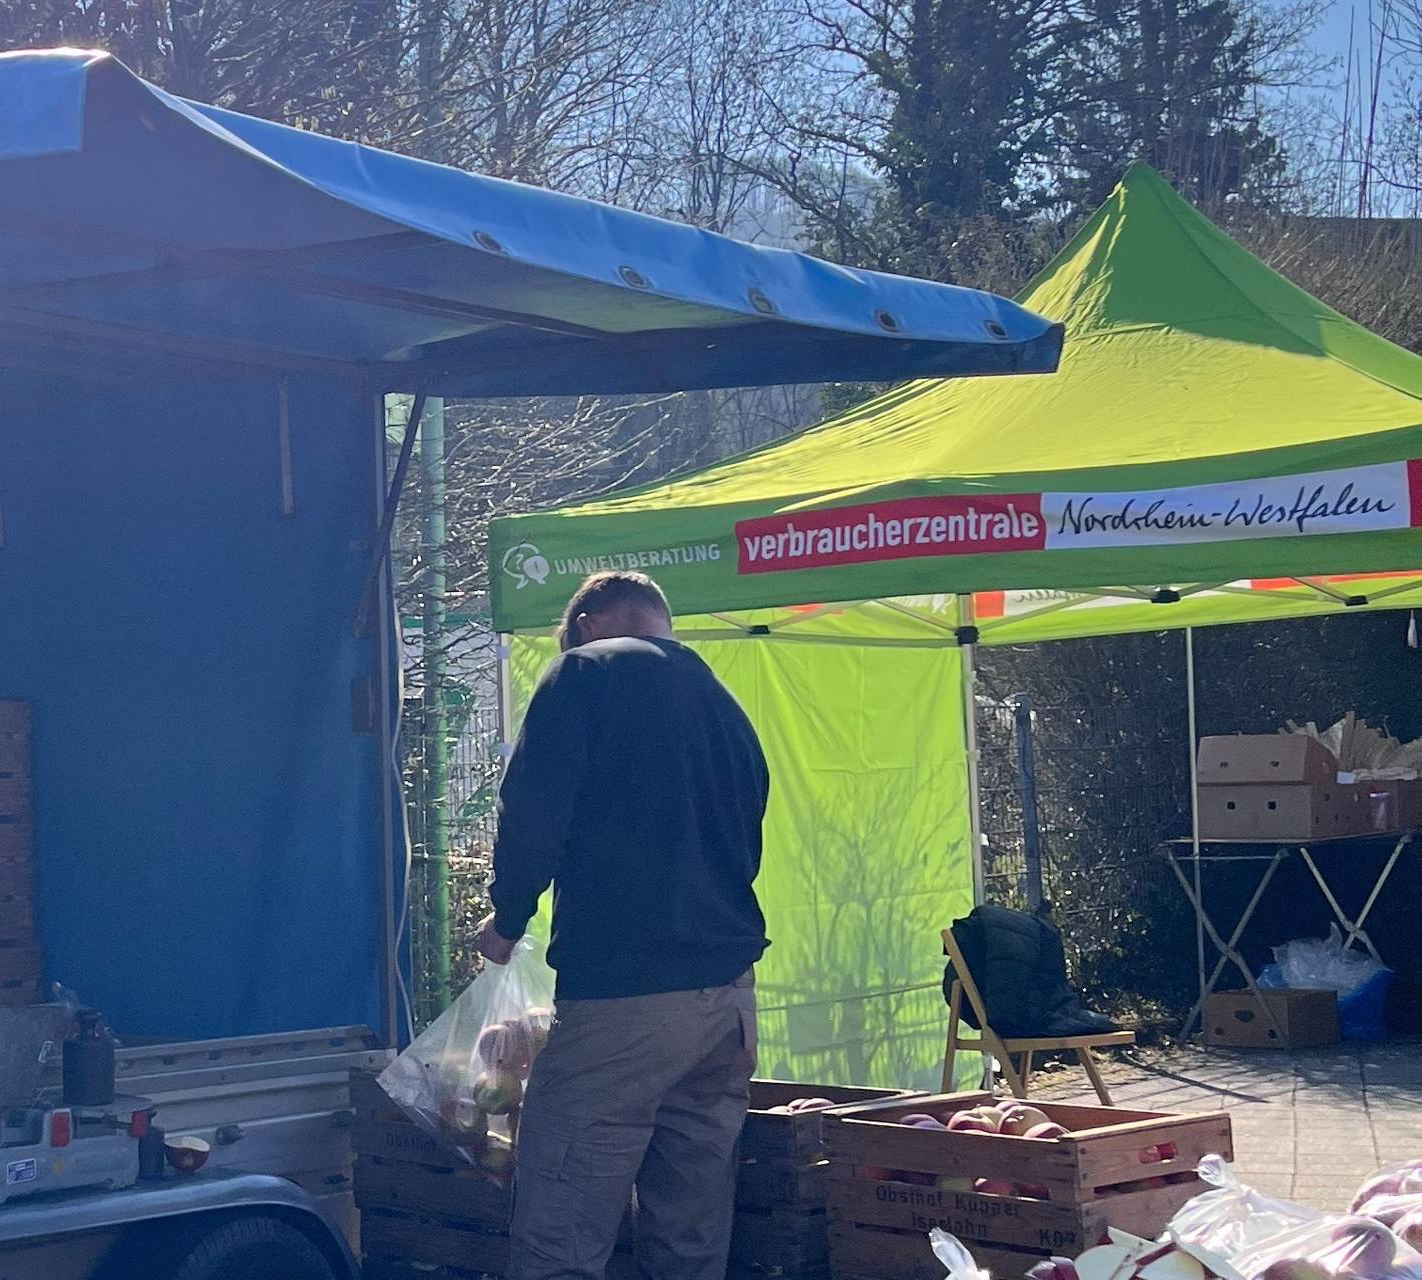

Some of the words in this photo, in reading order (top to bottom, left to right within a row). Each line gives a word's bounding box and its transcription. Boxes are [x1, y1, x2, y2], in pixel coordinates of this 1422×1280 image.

[744, 503, 1039, 561] verbraucherzentrale
[1058, 482, 1395, 533] Nordrhein-Westfalen
[554, 543, 722, 575] UMWELTBERATUNG
